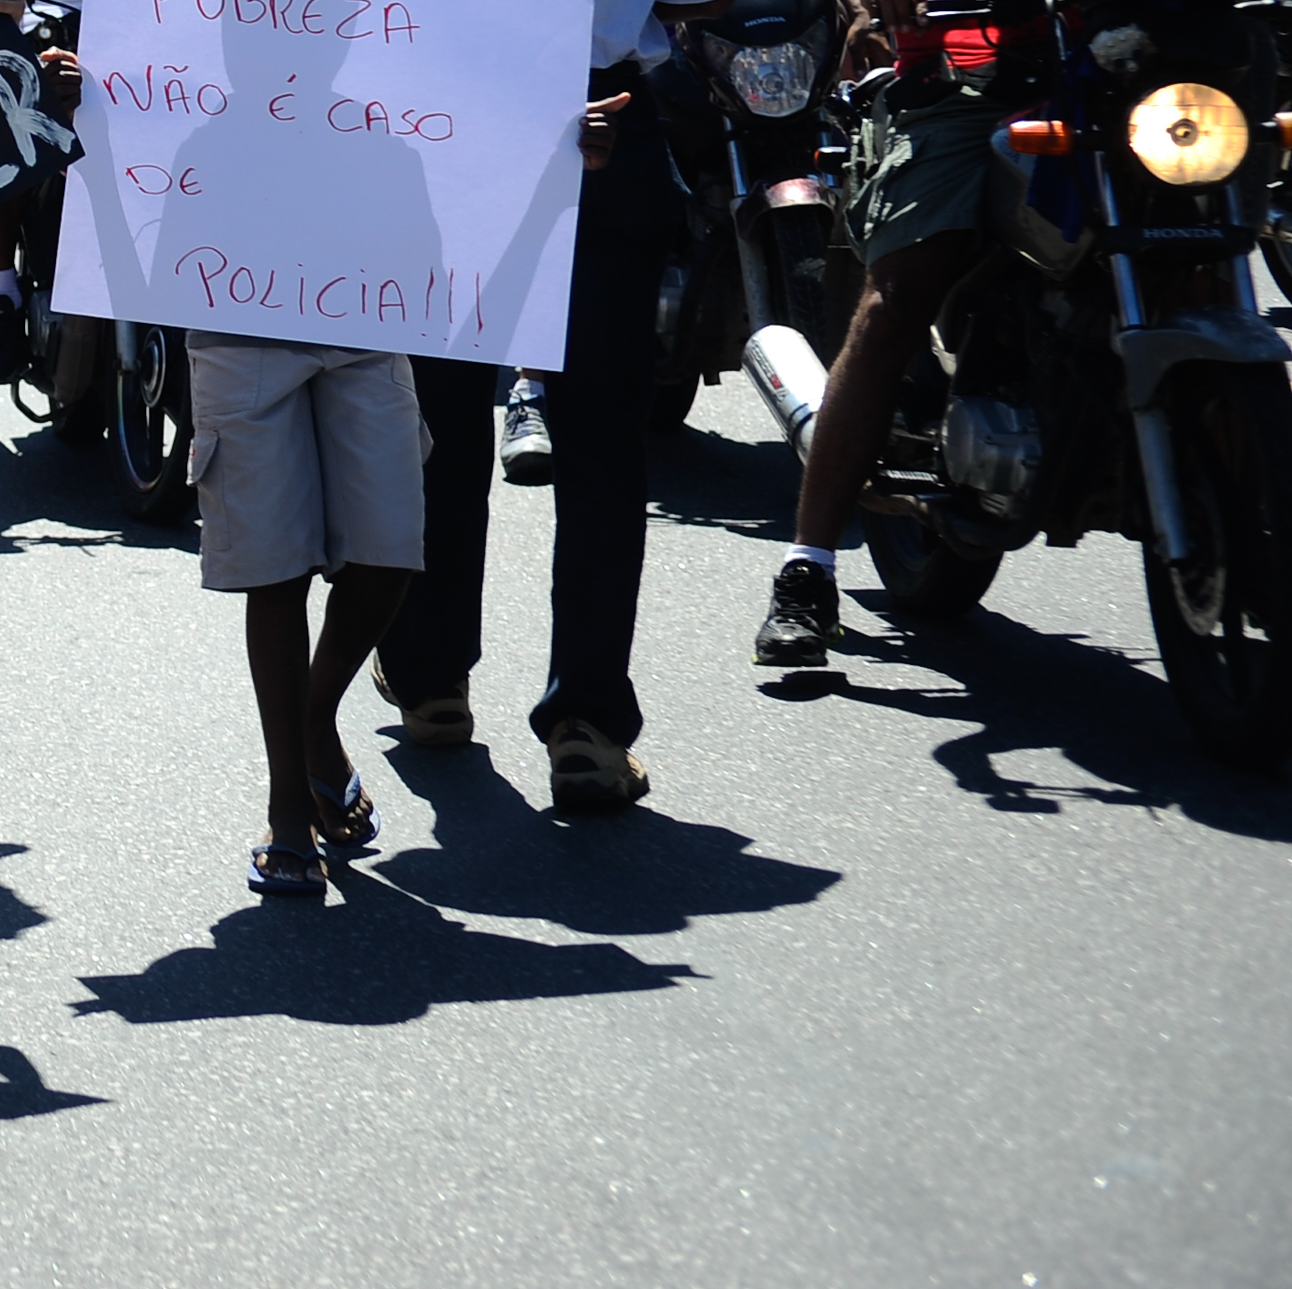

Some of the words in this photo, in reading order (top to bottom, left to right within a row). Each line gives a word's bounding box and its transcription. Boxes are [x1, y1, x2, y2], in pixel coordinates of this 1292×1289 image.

[103, 65, 228, 116] NÃO
[268, 73, 298, 121] É
[327, 99, 454, 141] CASO
[125, 163, 203, 196] DE
[1143, 228, 1224, 239] HONDA
